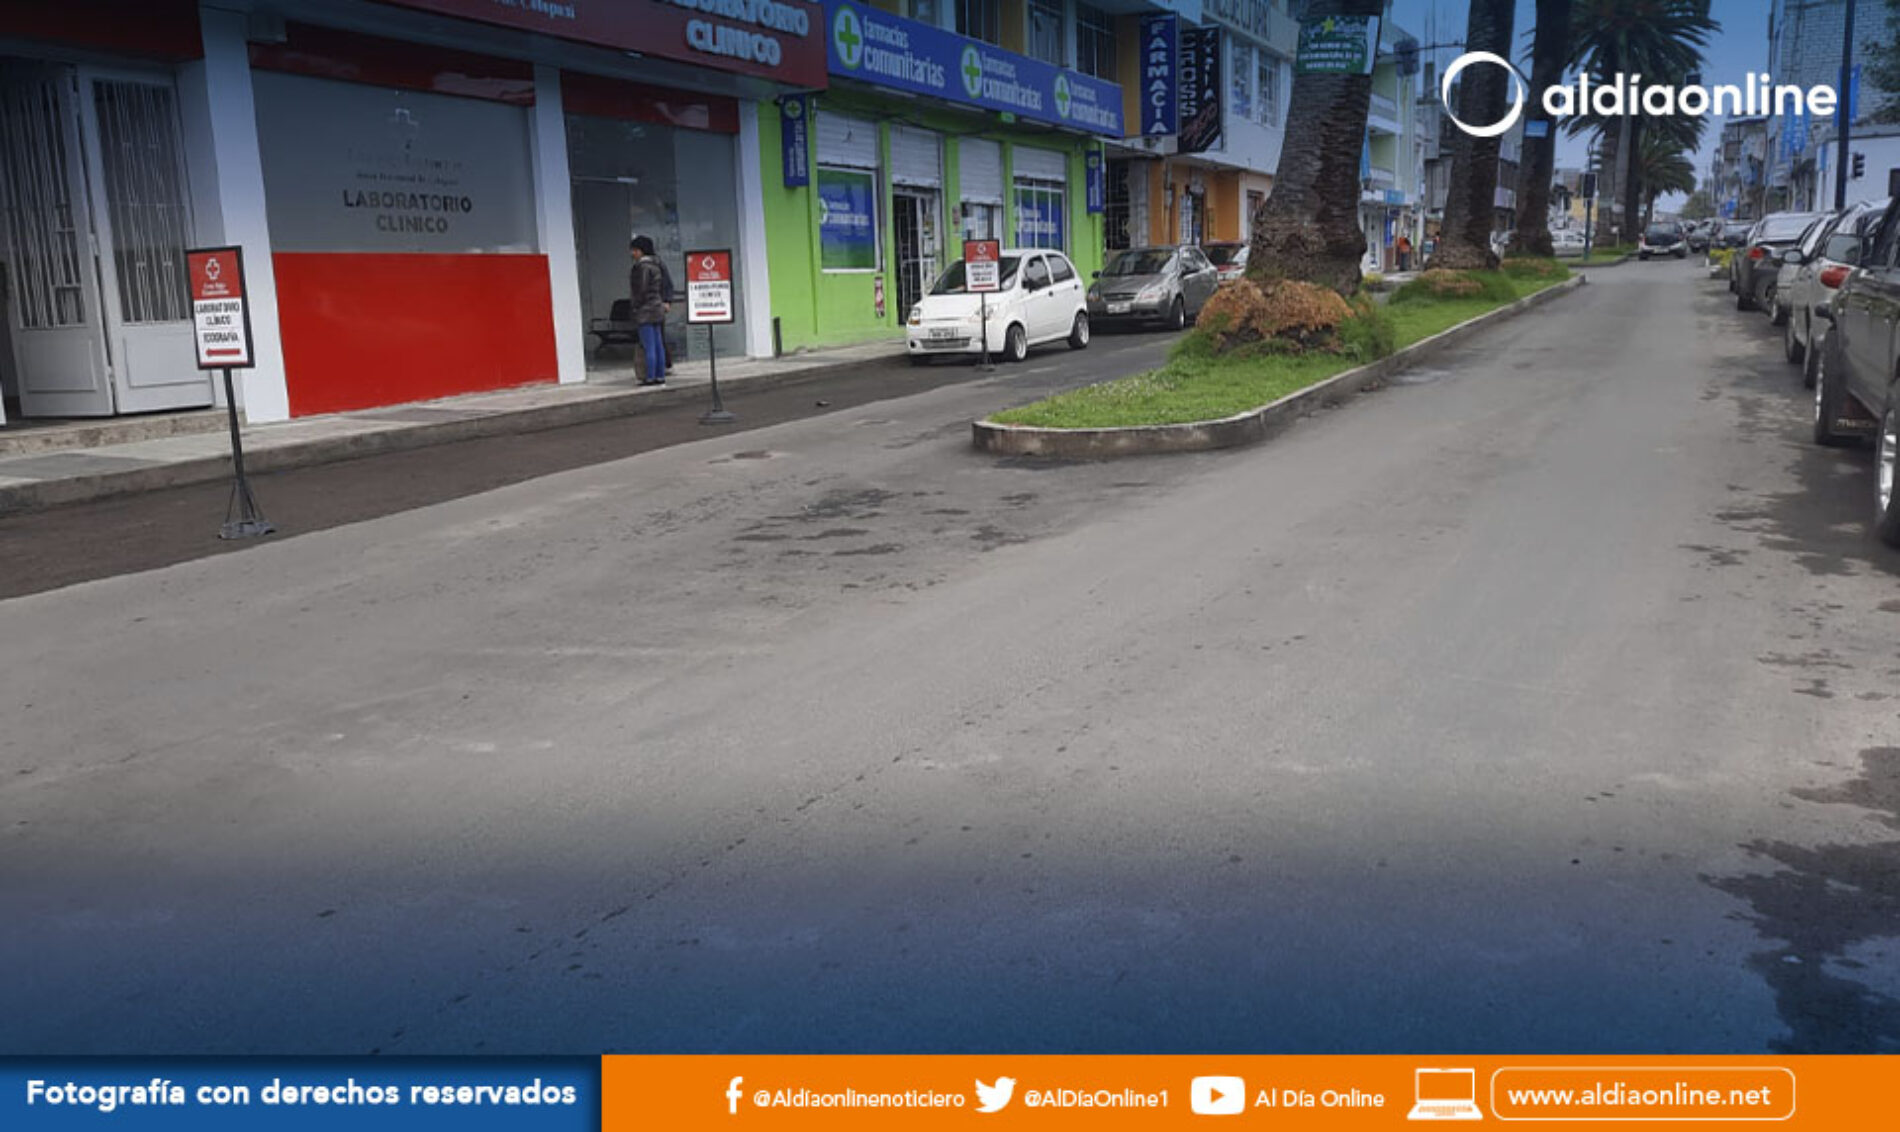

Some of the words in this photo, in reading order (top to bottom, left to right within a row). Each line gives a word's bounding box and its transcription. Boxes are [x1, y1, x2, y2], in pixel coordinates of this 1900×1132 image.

[686, 19, 781, 66] CLINICO
[864, 15, 909, 48] farmacias
[864, 45, 945, 88] comunitarias
[1147, 21, 1169, 134] FARMACIA
[983, 78, 1042, 111] comunitarias
[343, 189, 472, 213] LABORATORIO
[376, 214, 448, 233] CLINICO
